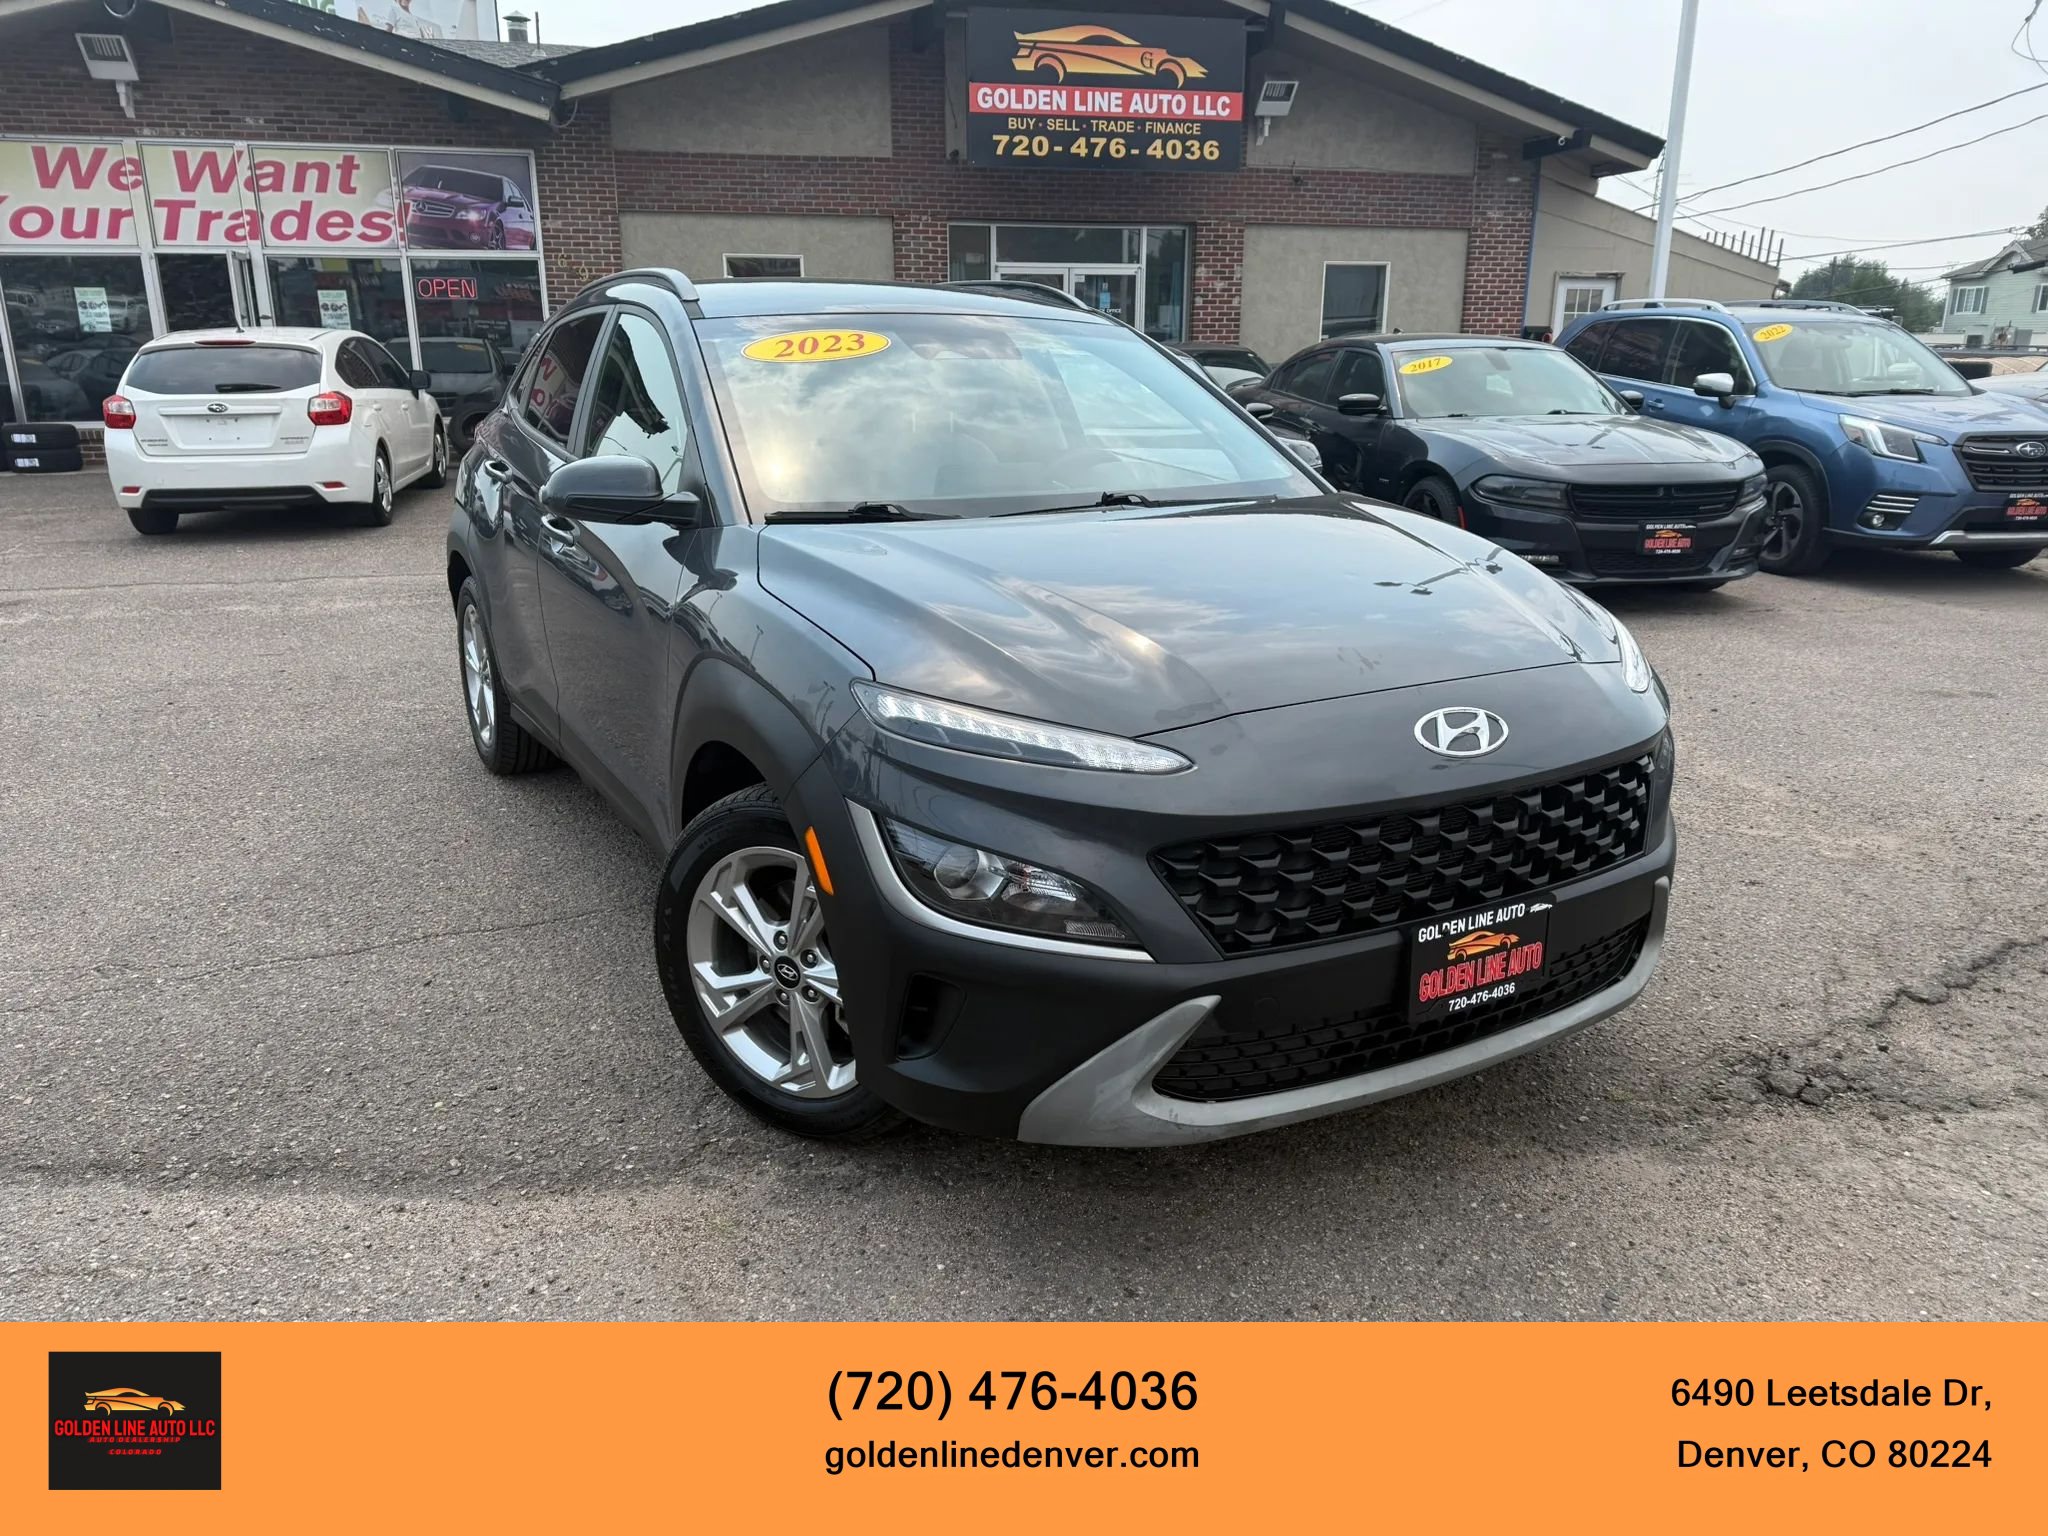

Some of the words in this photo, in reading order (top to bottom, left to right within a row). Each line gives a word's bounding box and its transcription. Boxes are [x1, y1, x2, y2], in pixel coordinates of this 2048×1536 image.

[977, 87, 1067, 112] GOLDEN
[1074, 90, 1123, 113] LINE
[1129, 92, 1187, 115] AUTO
[1193, 95, 1231, 117] LLC
[1008, 117, 1036, 130] BUY
[1047, 119, 1080, 132] SELL
[1091, 120, 1134, 133] TRADE
[1145, 121, 1201, 135] FINANCE
[31, 145, 143, 191] We
[172, 150, 360, 194] Want
[0, 195, 134, 240] our
[154, 199, 411, 243] Trades!
[418, 278, 476, 298] OPEN
[774, 333, 865, 358] 2023
[1760, 325, 1786, 340] 2022
[1410, 357, 1441, 373] 2017
[1418, 917, 1466, 943] GOLDEN
[1468, 910, 1494, 930] LINE
[1496, 903, 1525, 924] AUTO
[1419, 961, 1475, 1001] GOLDEN
[1477, 951, 1507, 986] LINE
[1508, 941, 1543, 976] AUTO
[1448, 982, 1516, 1012] 720-476-4036
